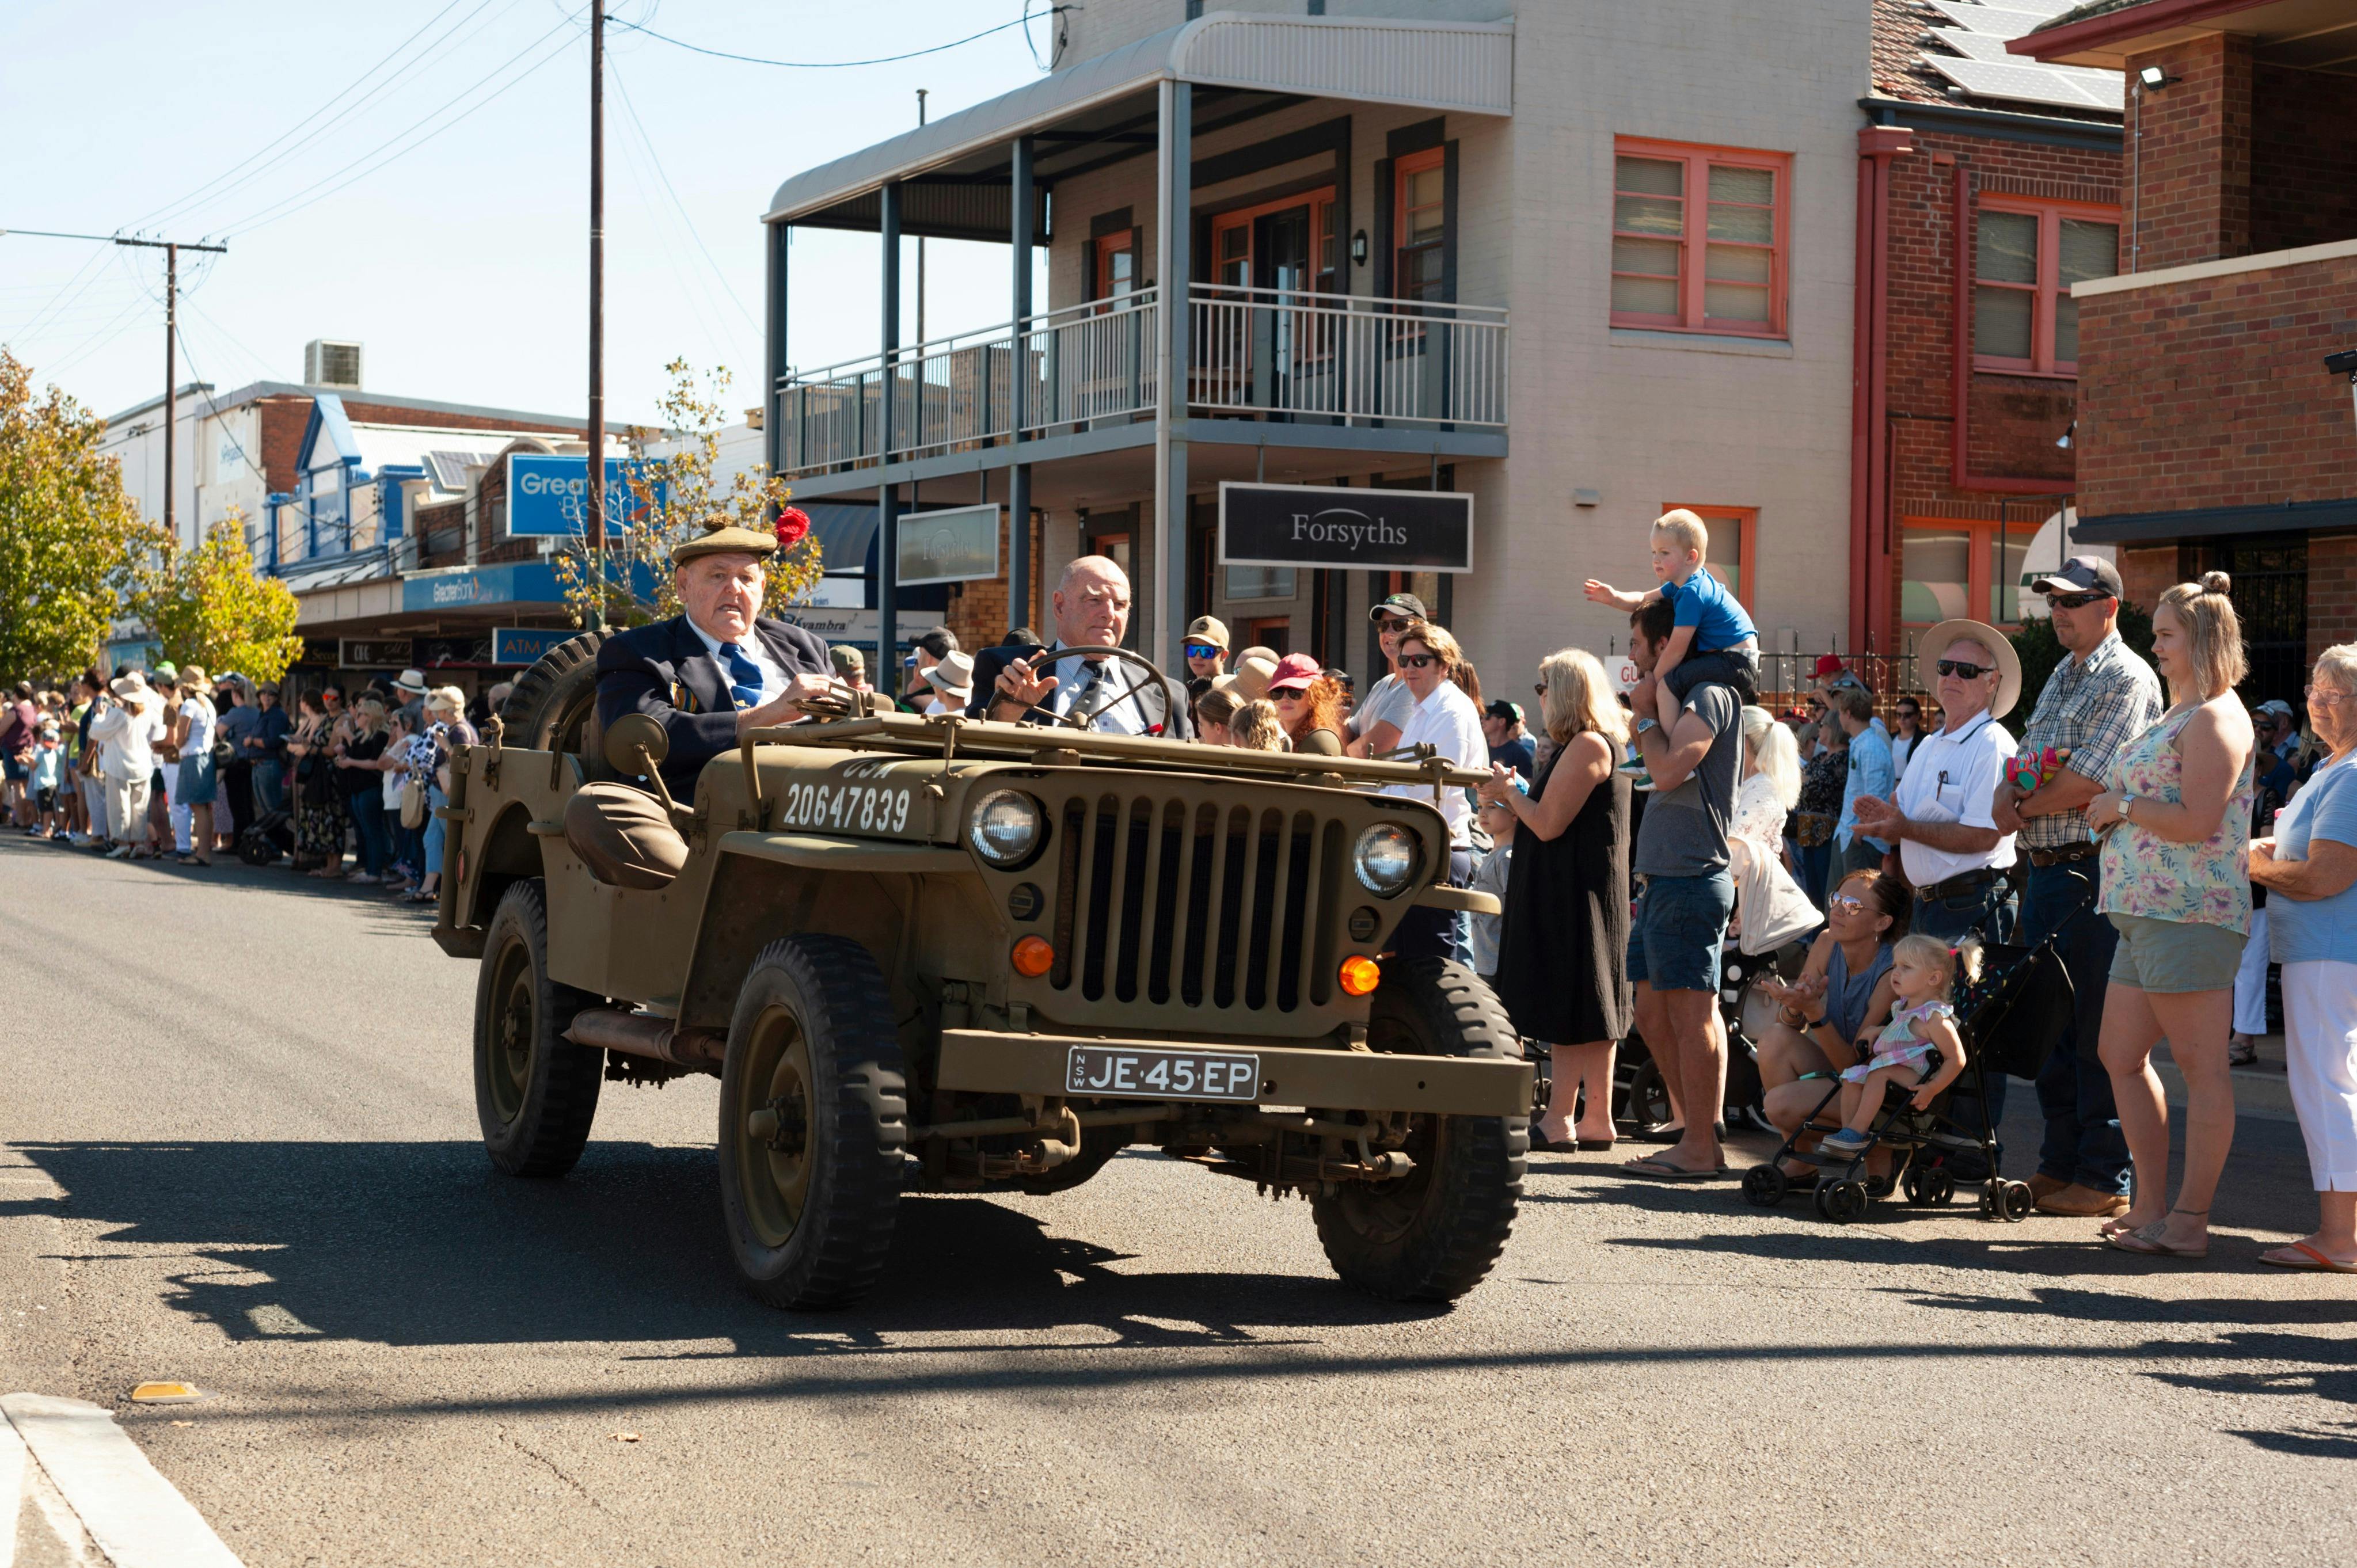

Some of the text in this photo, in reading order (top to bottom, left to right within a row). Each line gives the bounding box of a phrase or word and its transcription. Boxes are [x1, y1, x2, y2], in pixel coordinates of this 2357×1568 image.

[1291, 514, 1407, 550] Forsyths
[923, 534, 970, 565] Forsyths
[504, 640, 541, 654] ATM
[784, 783, 910, 832] 20647839
